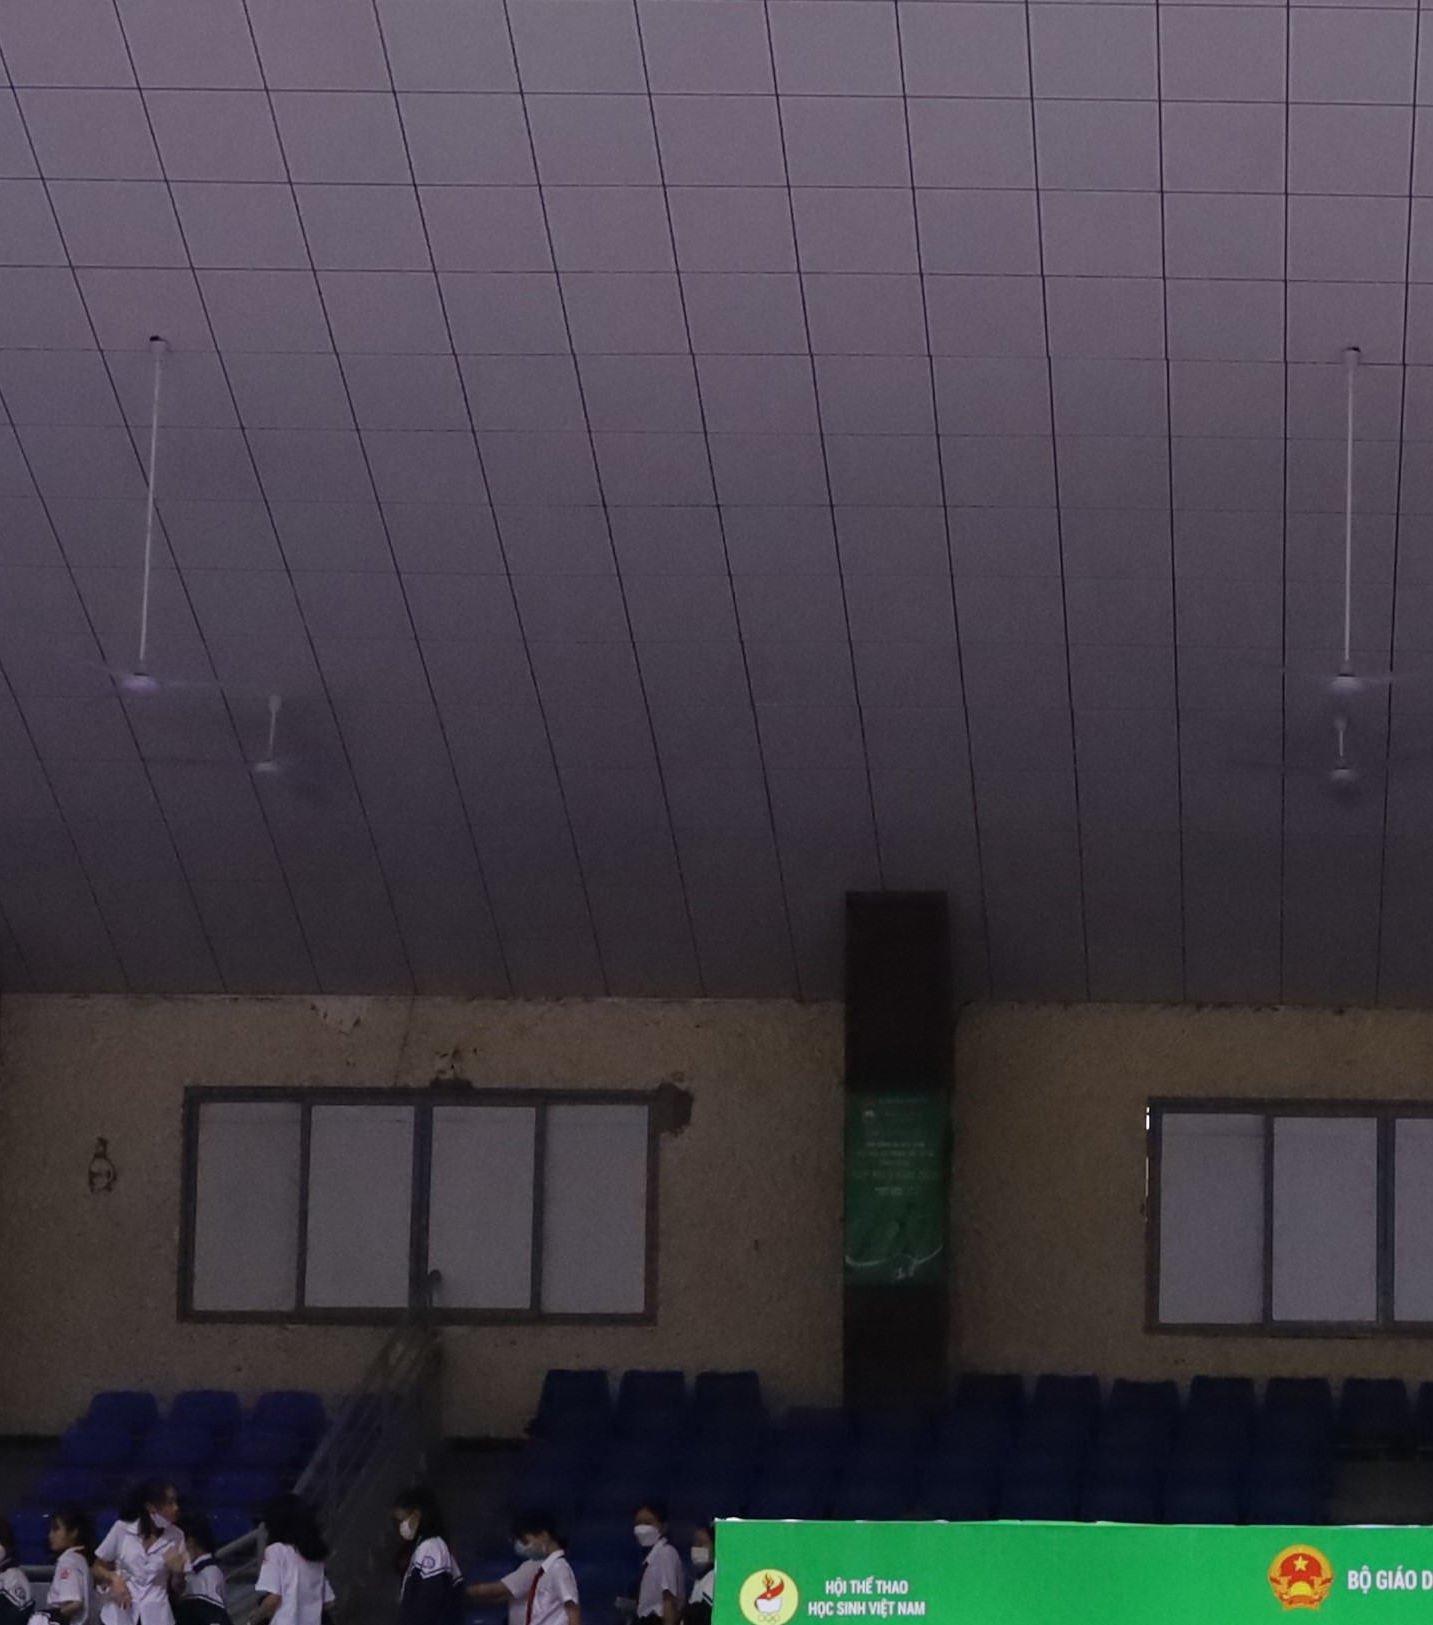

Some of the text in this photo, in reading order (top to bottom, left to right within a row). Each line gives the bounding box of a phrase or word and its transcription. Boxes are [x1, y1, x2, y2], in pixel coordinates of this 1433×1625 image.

[825, 1577, 847, 1597] HỘI
[875, 1580, 909, 1594] THAO
[1347, 1565, 1372, 1594] BỘ
[1375, 1565, 1417, 1590] GIÁO
[808, 1598, 926, 1618] HỌC SINH VIỆT NAM
